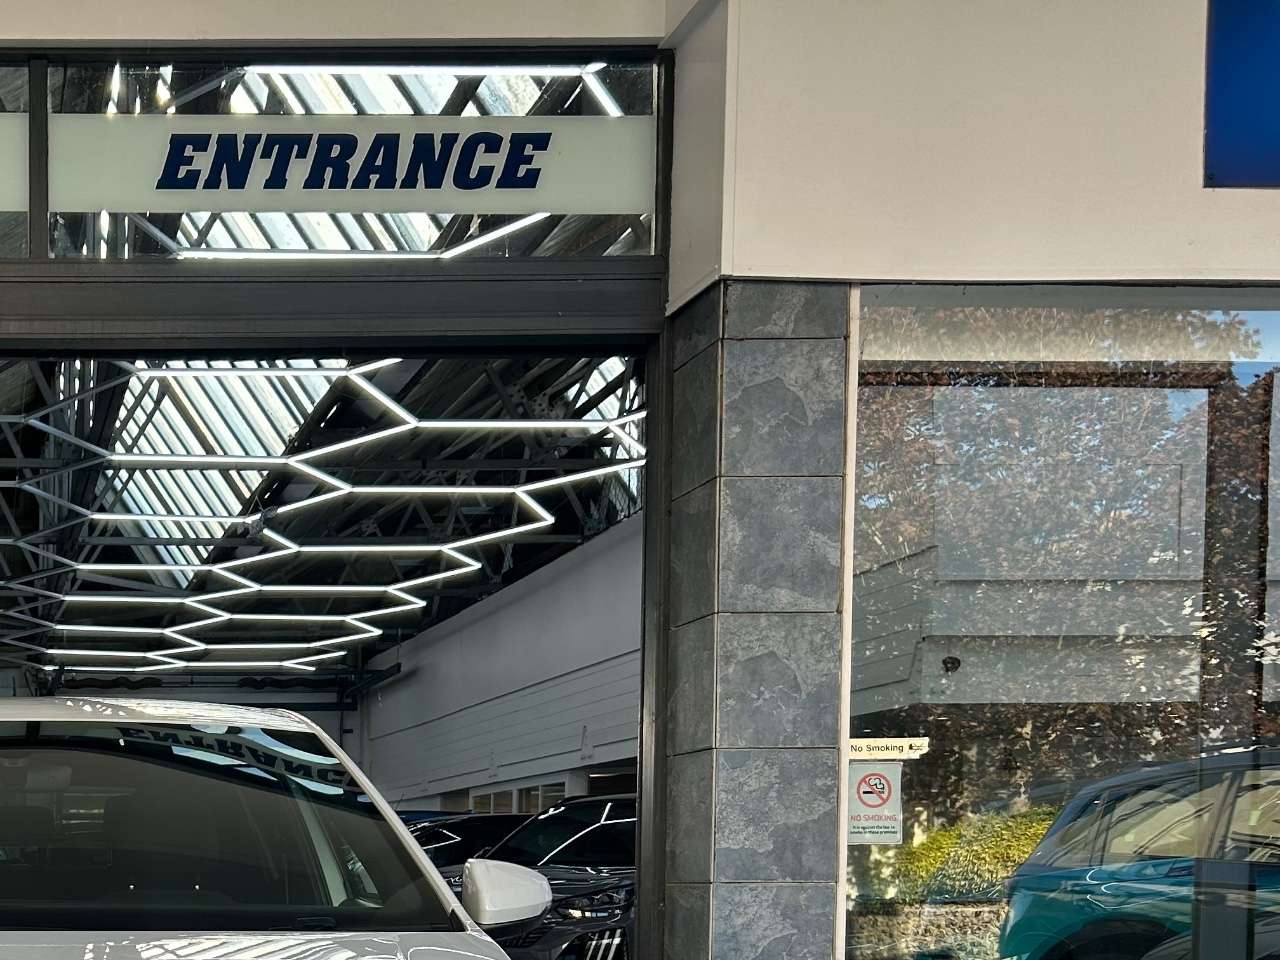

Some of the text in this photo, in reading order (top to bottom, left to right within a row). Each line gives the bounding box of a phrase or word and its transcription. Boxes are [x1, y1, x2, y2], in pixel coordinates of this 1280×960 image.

[155, 131, 553, 191] ENTRANCE
[850, 744, 904, 752] No Smoking
[850, 814, 897, 822] NO SMOKING
